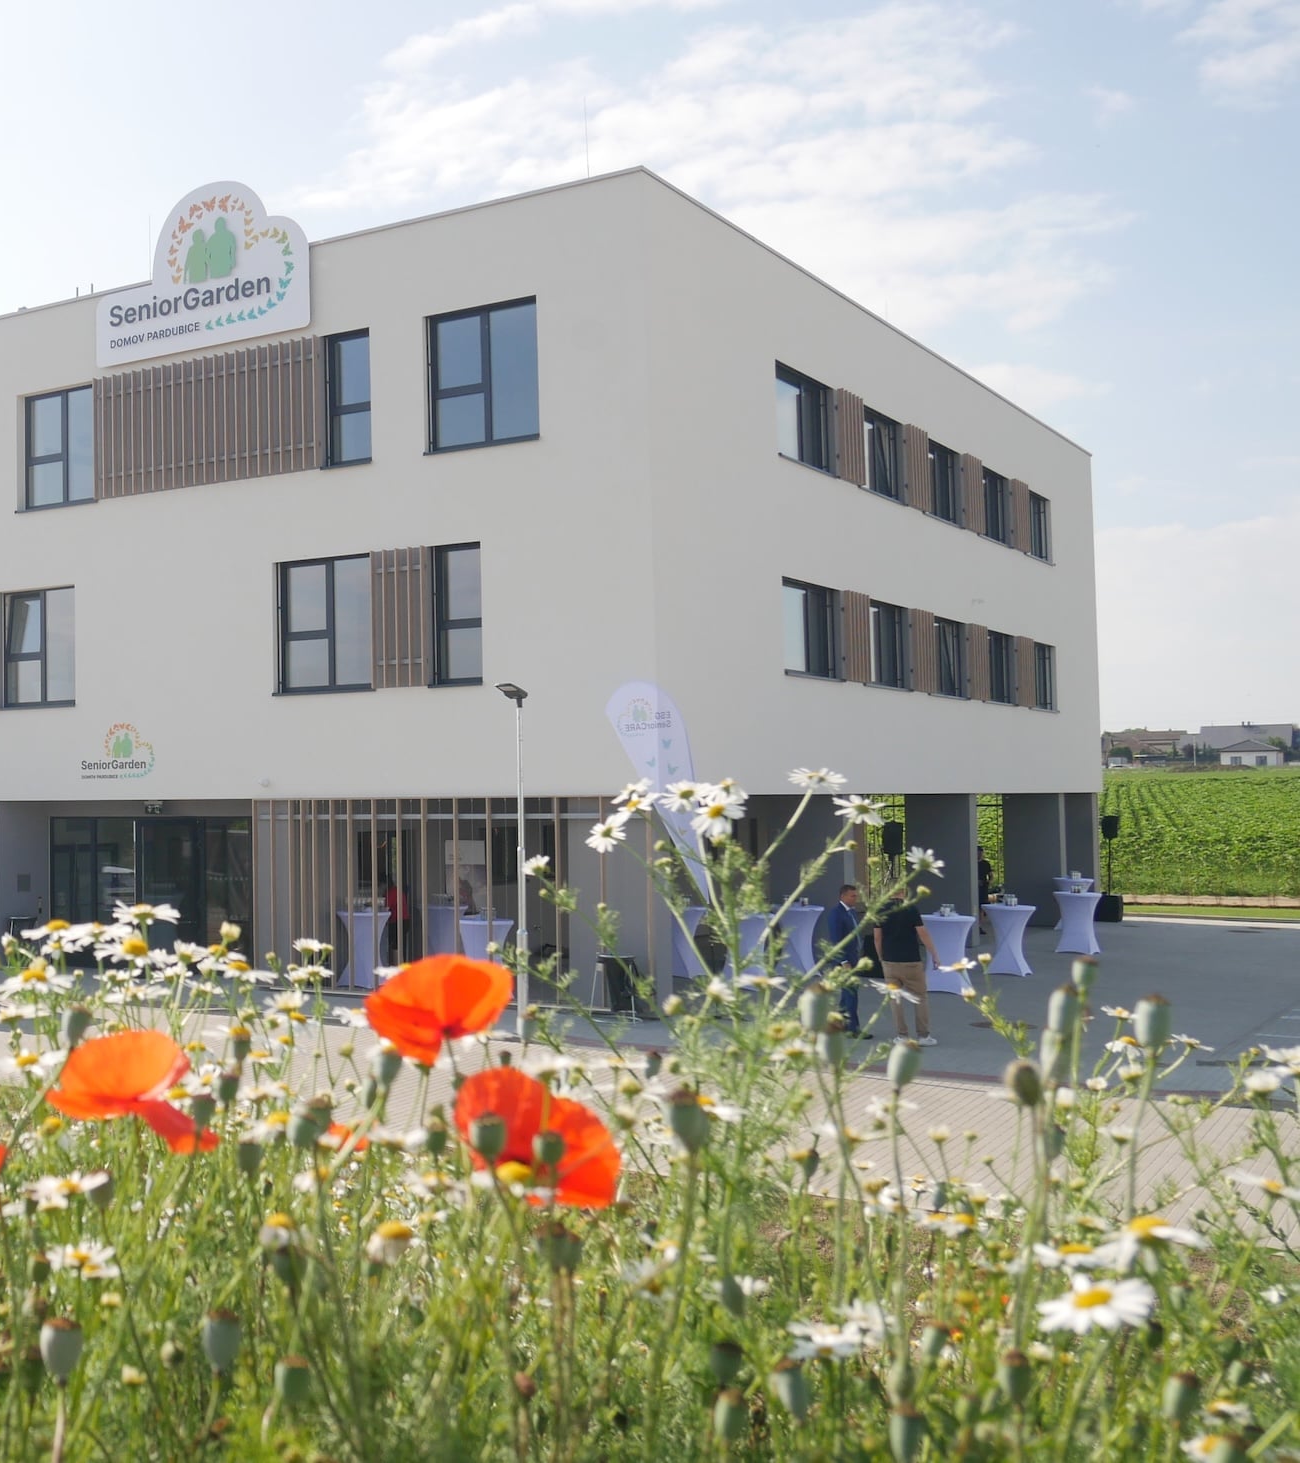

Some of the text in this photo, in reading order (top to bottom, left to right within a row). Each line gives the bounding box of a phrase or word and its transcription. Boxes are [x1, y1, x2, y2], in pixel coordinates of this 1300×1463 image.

[109, 276, 271, 327] SeniorGarden
[110, 321, 200, 349] DOMOV PARDUBICE
[81, 759, 147, 770] SeniorGarden
